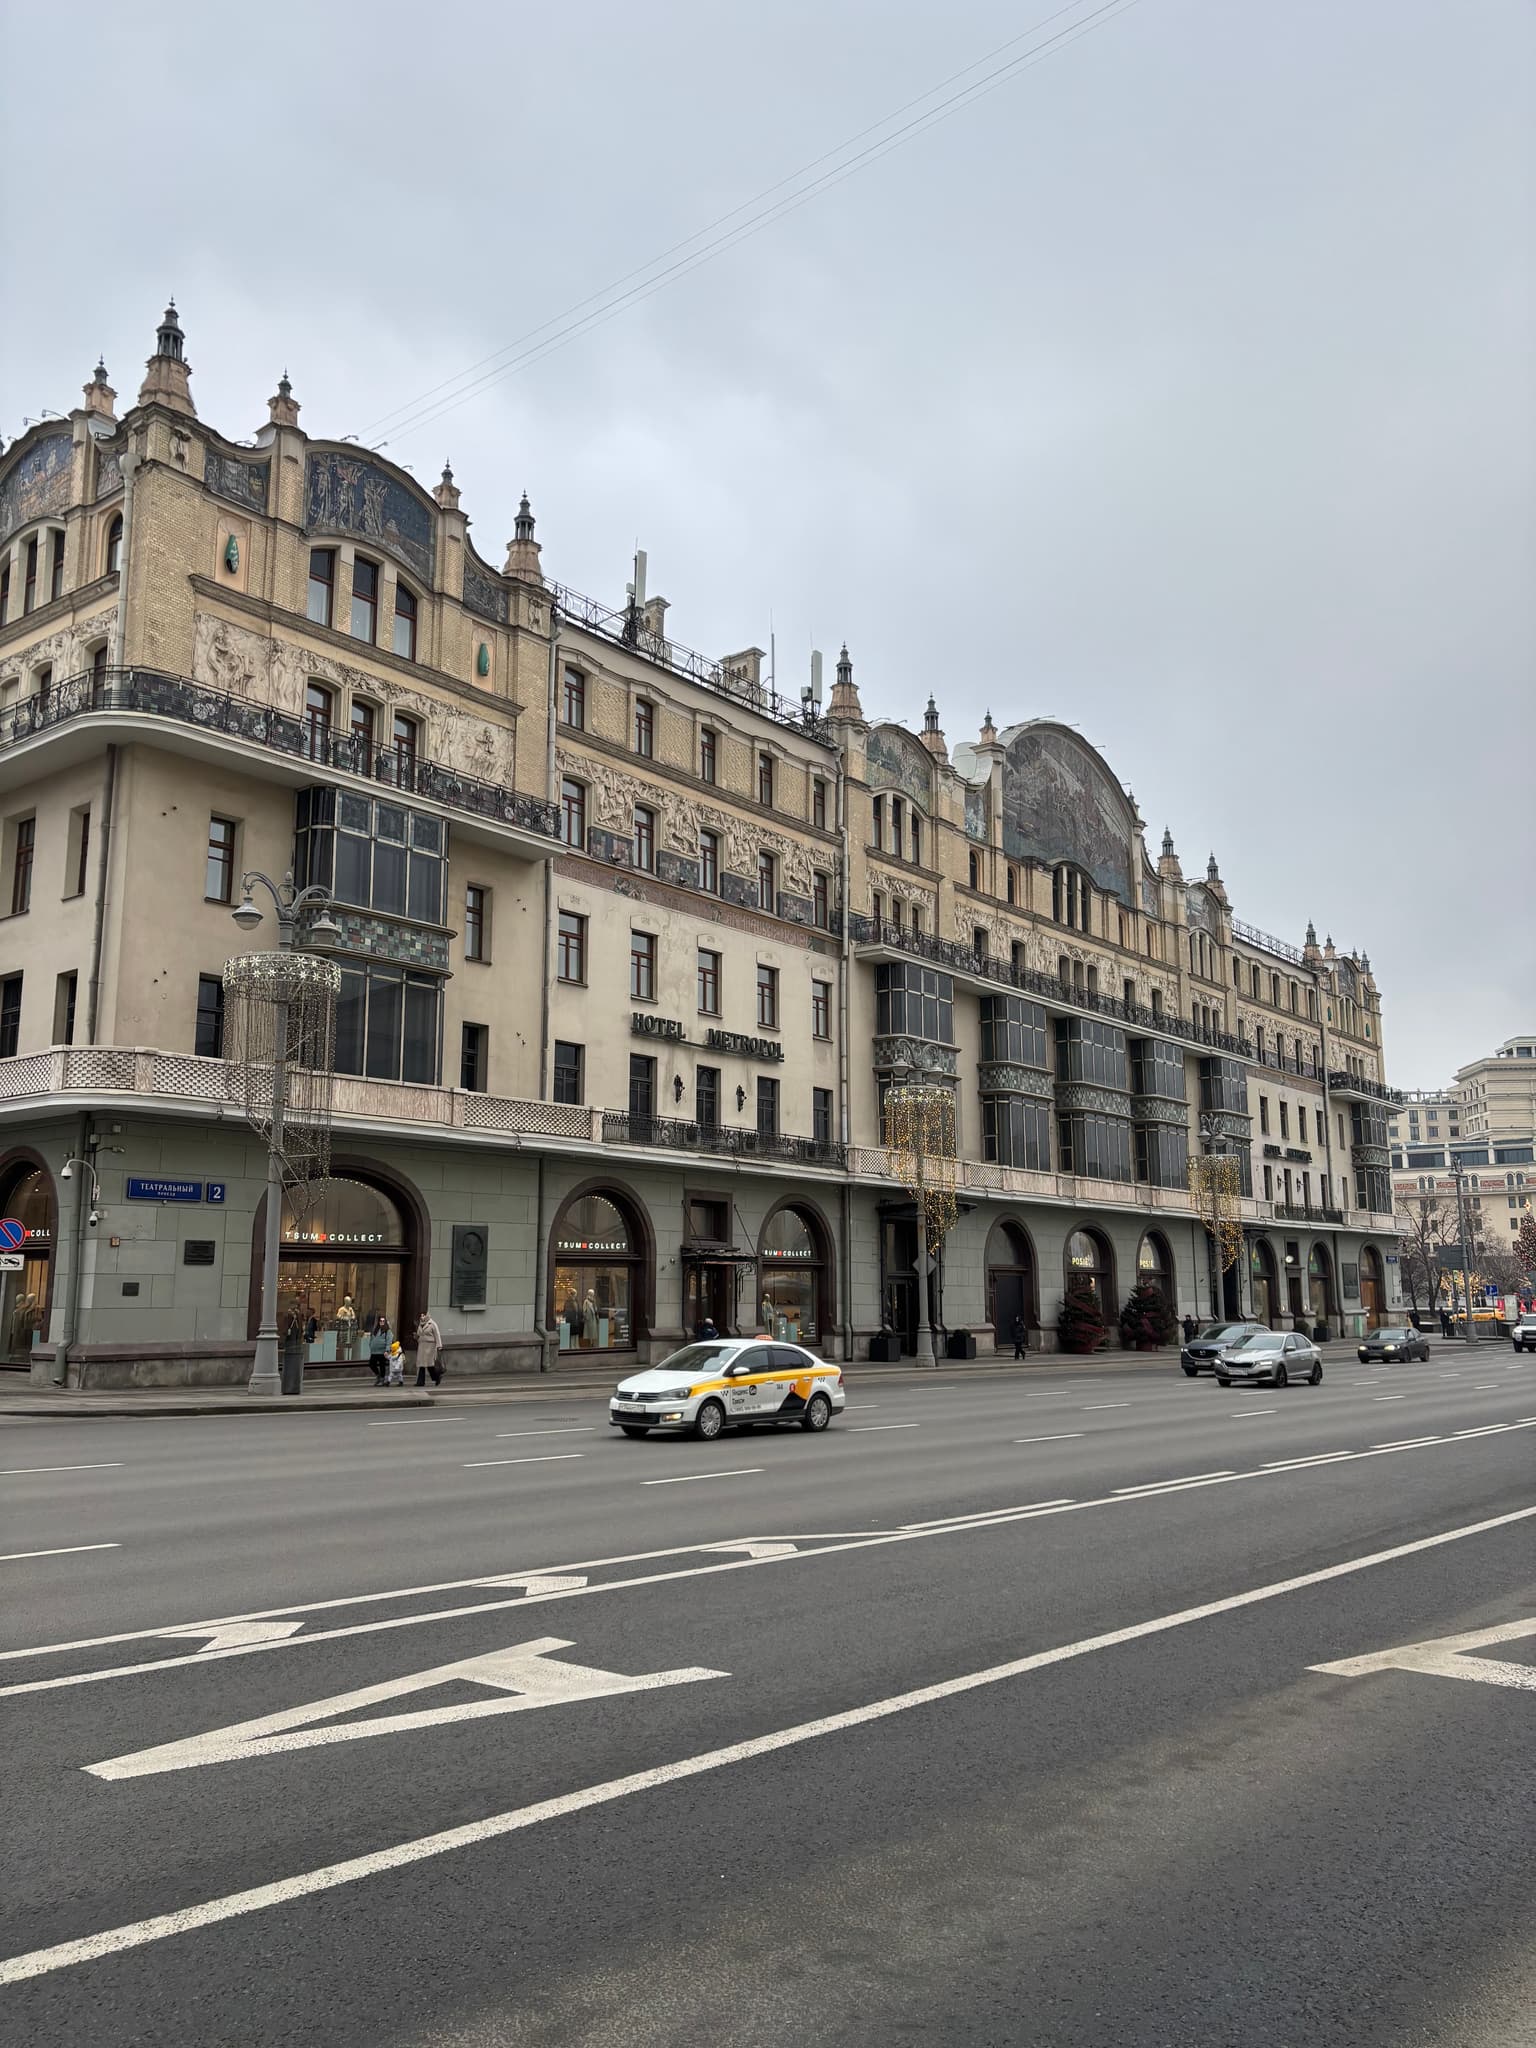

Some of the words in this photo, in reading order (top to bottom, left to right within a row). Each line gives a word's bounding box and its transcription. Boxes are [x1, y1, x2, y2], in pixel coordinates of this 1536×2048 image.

[632, 1012, 686, 1040] HOTEL
[707, 1028, 785, 1059] METROPOL
[140, 1183, 194, 1193] ТЕАТРАЛЬНЫЙ
[213, 1186, 221, 1199] 2
[30, 1229, 51, 1237] COLL
[285, 1231, 319, 1241] TSUM
[329, 1233, 383, 1242] COLLECT
[558, 1241, 582, 1249] TSUM
